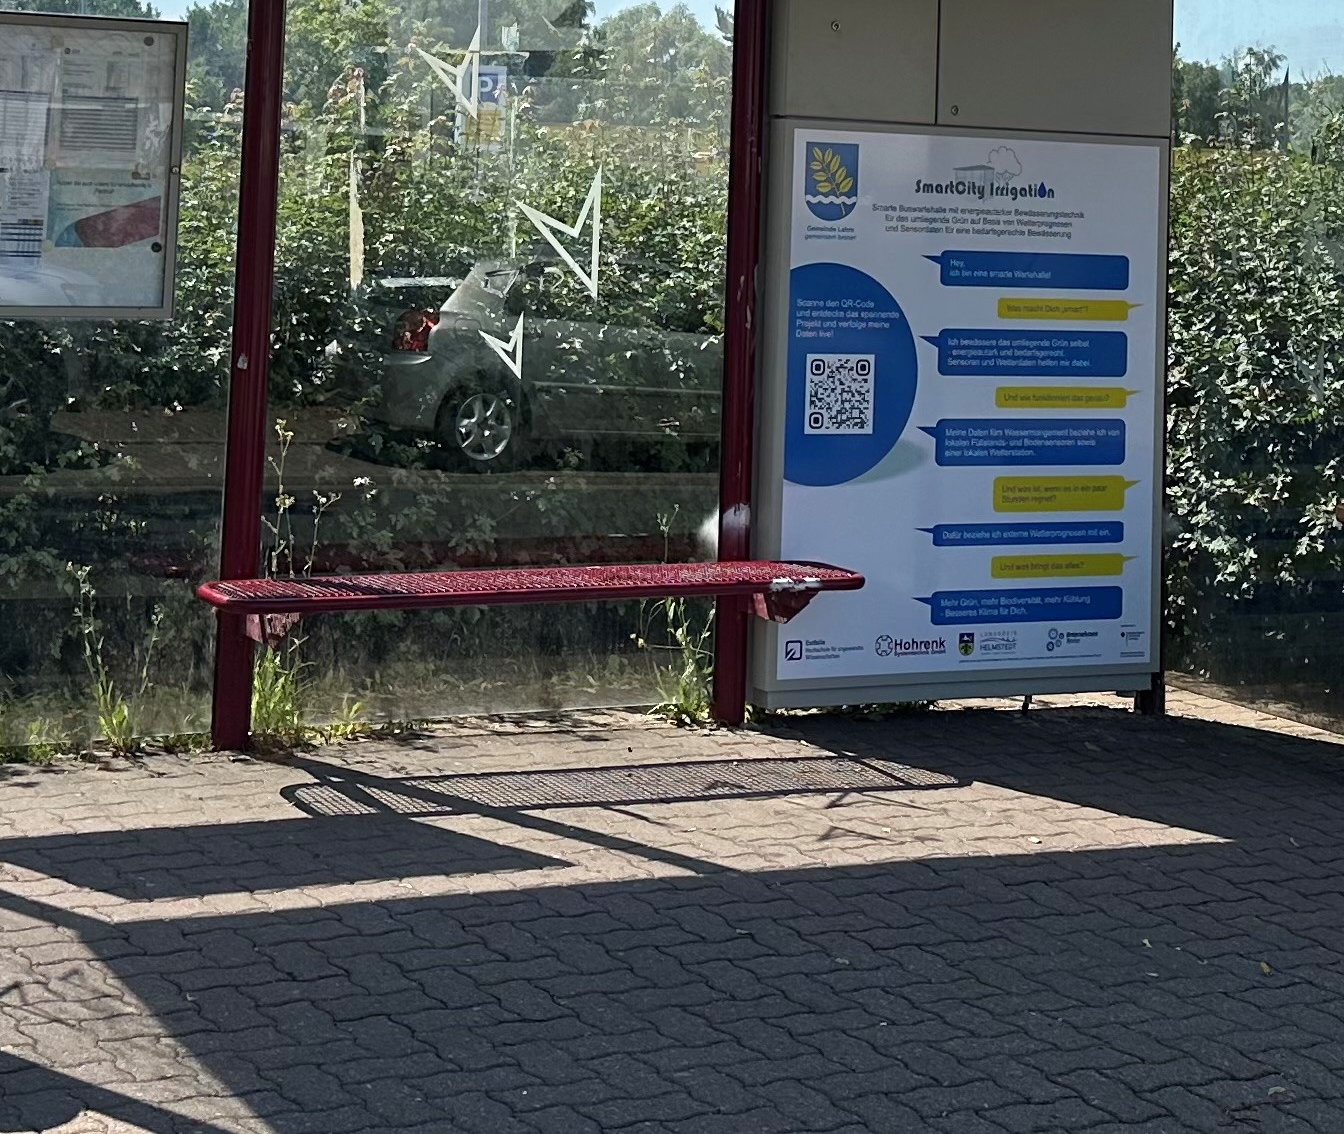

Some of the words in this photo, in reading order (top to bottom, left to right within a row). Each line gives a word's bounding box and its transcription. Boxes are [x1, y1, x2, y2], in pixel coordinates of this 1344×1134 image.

[915, 179, 985, 200] SmartCity
[956, 227, 970, 236] eine
[840, 300, 874, 308] QR-Code
[895, 637, 946, 650] Hohrenk
